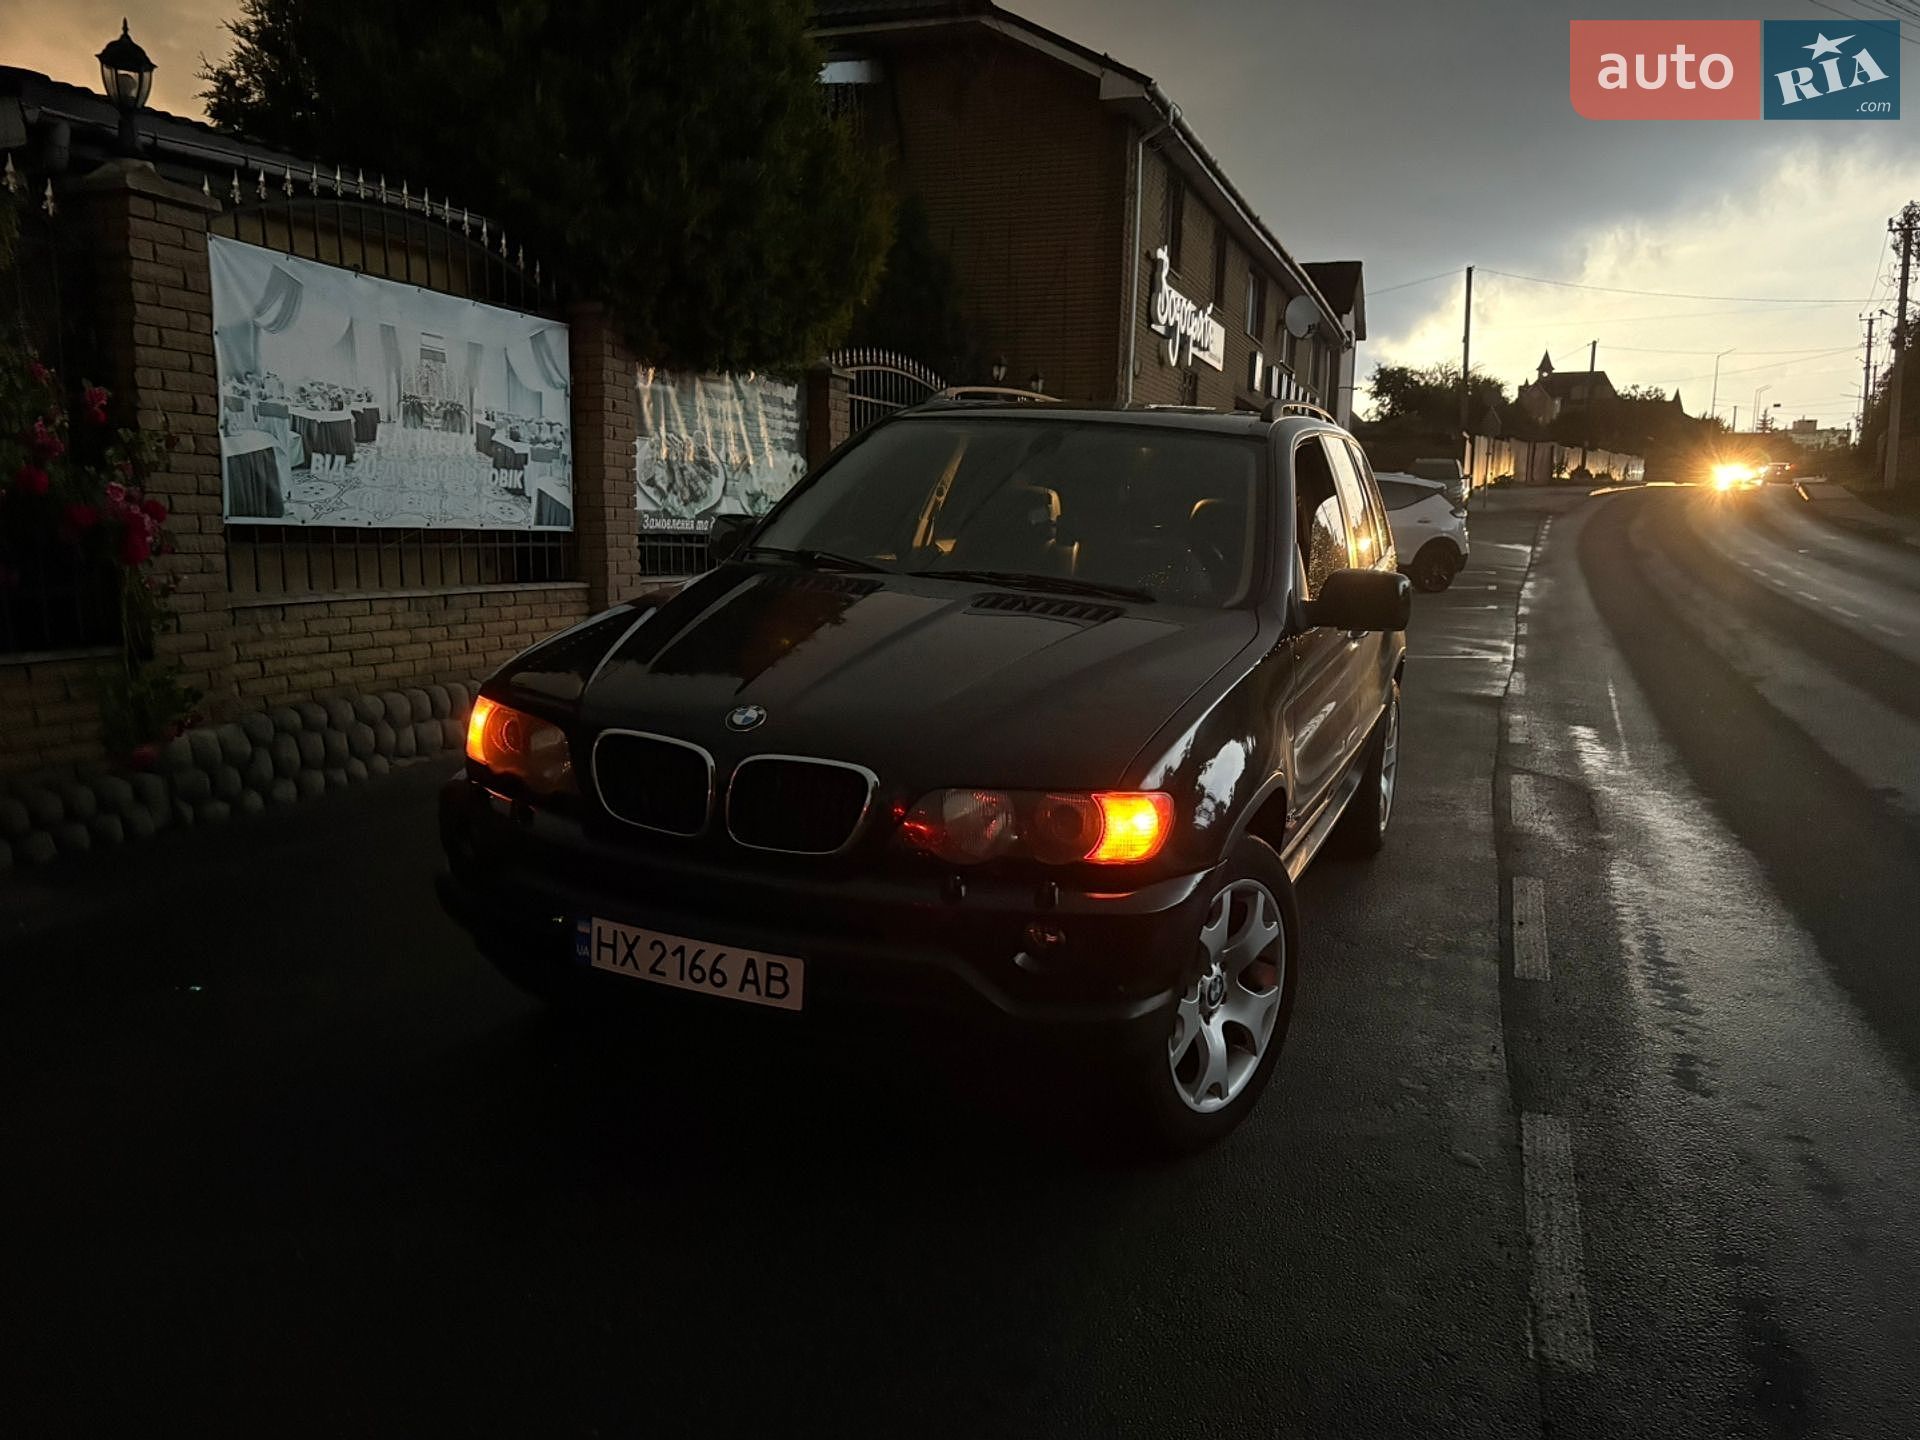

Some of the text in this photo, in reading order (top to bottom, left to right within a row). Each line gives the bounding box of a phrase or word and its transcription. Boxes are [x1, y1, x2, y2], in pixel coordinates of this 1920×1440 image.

[310, 452, 346, 481] ВІД
[596, 925, 791, 1001] HX 2166 AB
